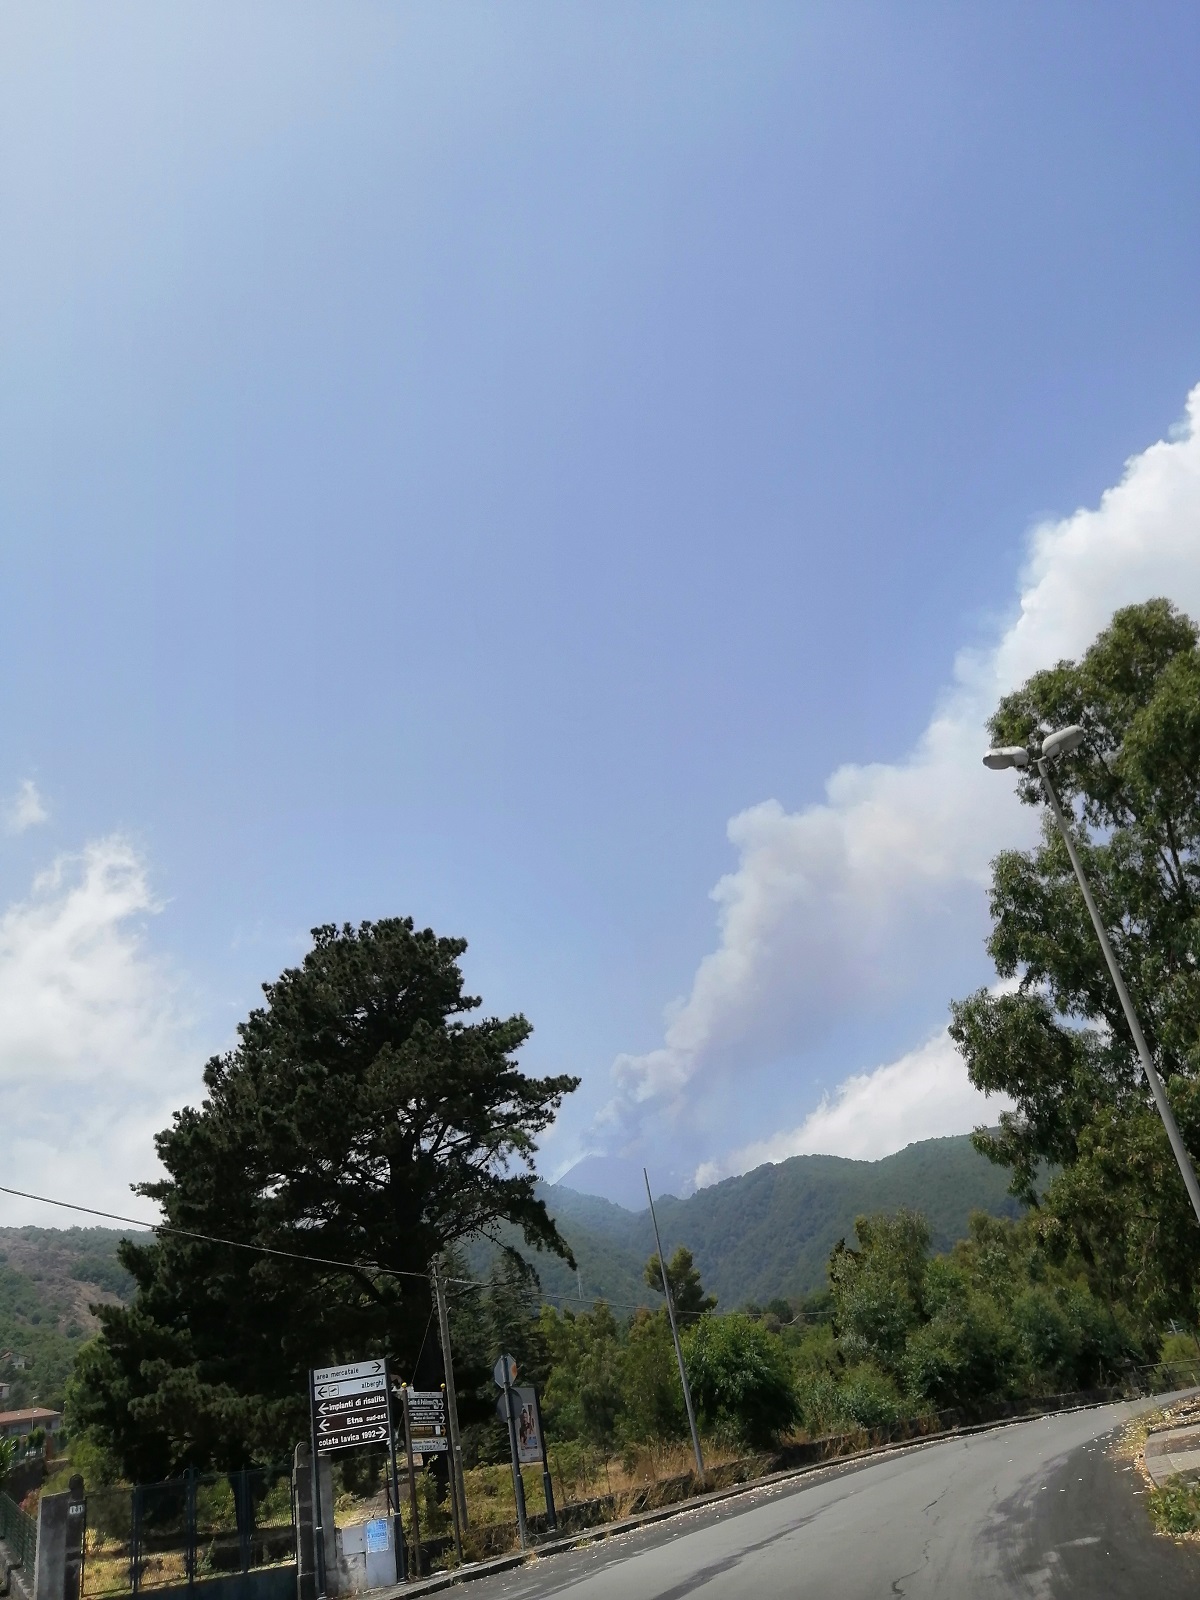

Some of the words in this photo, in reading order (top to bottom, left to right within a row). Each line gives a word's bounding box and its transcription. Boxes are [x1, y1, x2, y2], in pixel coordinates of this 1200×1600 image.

[331, 1367, 359, 1378] mercatale
[361, 1379, 384, 1388] alberghi
[329, 1399, 353, 1411] impianti
[363, 1395, 385, 1405] risalita
[346, 1417, 363, 1425] Etna
[318, 1437, 339, 1446] colata
[340, 1433, 360, 1442] lavica
[361, 1430, 376, 1439] 1992
